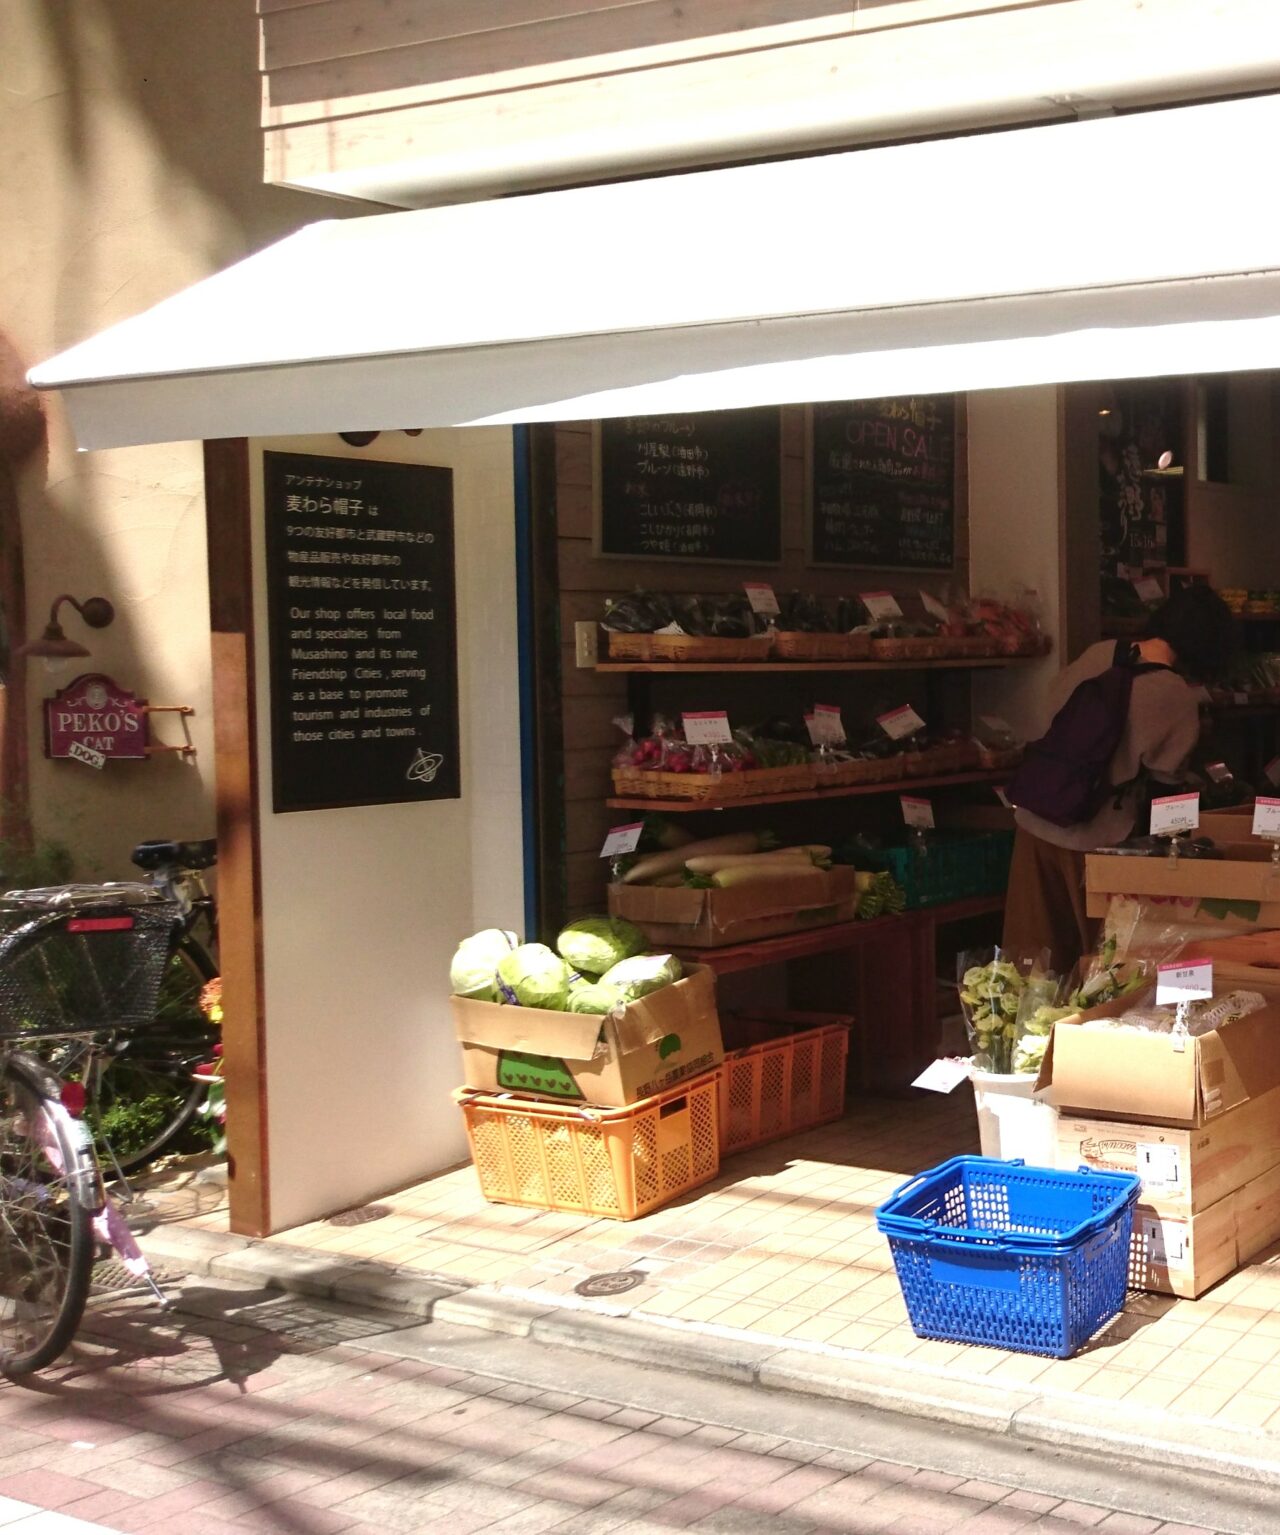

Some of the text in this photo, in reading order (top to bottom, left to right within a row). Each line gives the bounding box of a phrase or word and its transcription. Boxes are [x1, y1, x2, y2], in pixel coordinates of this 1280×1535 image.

[846, 420, 897, 451] OPEN
[284, 474, 362, 490] アンテナショップ
[286, 495, 364, 516] 麦わら帽子
[286, 525, 435, 544] 9つの友好都市と武蔵野市などの
[287, 551, 402, 566] 物産品販売や友好都市の
[288, 575, 432, 592] 観光情報などを発信しています。
[290, 607, 435, 623] Our shop offers local food
[291, 627, 402, 641] and specialties from
[291, 648, 418, 660] Musashino and its nine
[291, 668, 347, 682] Friendship
[391, 667, 426, 681] serving
[292, 688, 409, 701] as a base to promote
[58, 709, 139, 732] PEKO'S
[293, 705, 431, 721] tourism and industries of
[293, 730, 324, 742] those
[328, 728, 355, 740] cities
[361, 727, 381, 738] and
[83, 736, 114, 751] CAT
[73, 745, 99, 765] DOG
